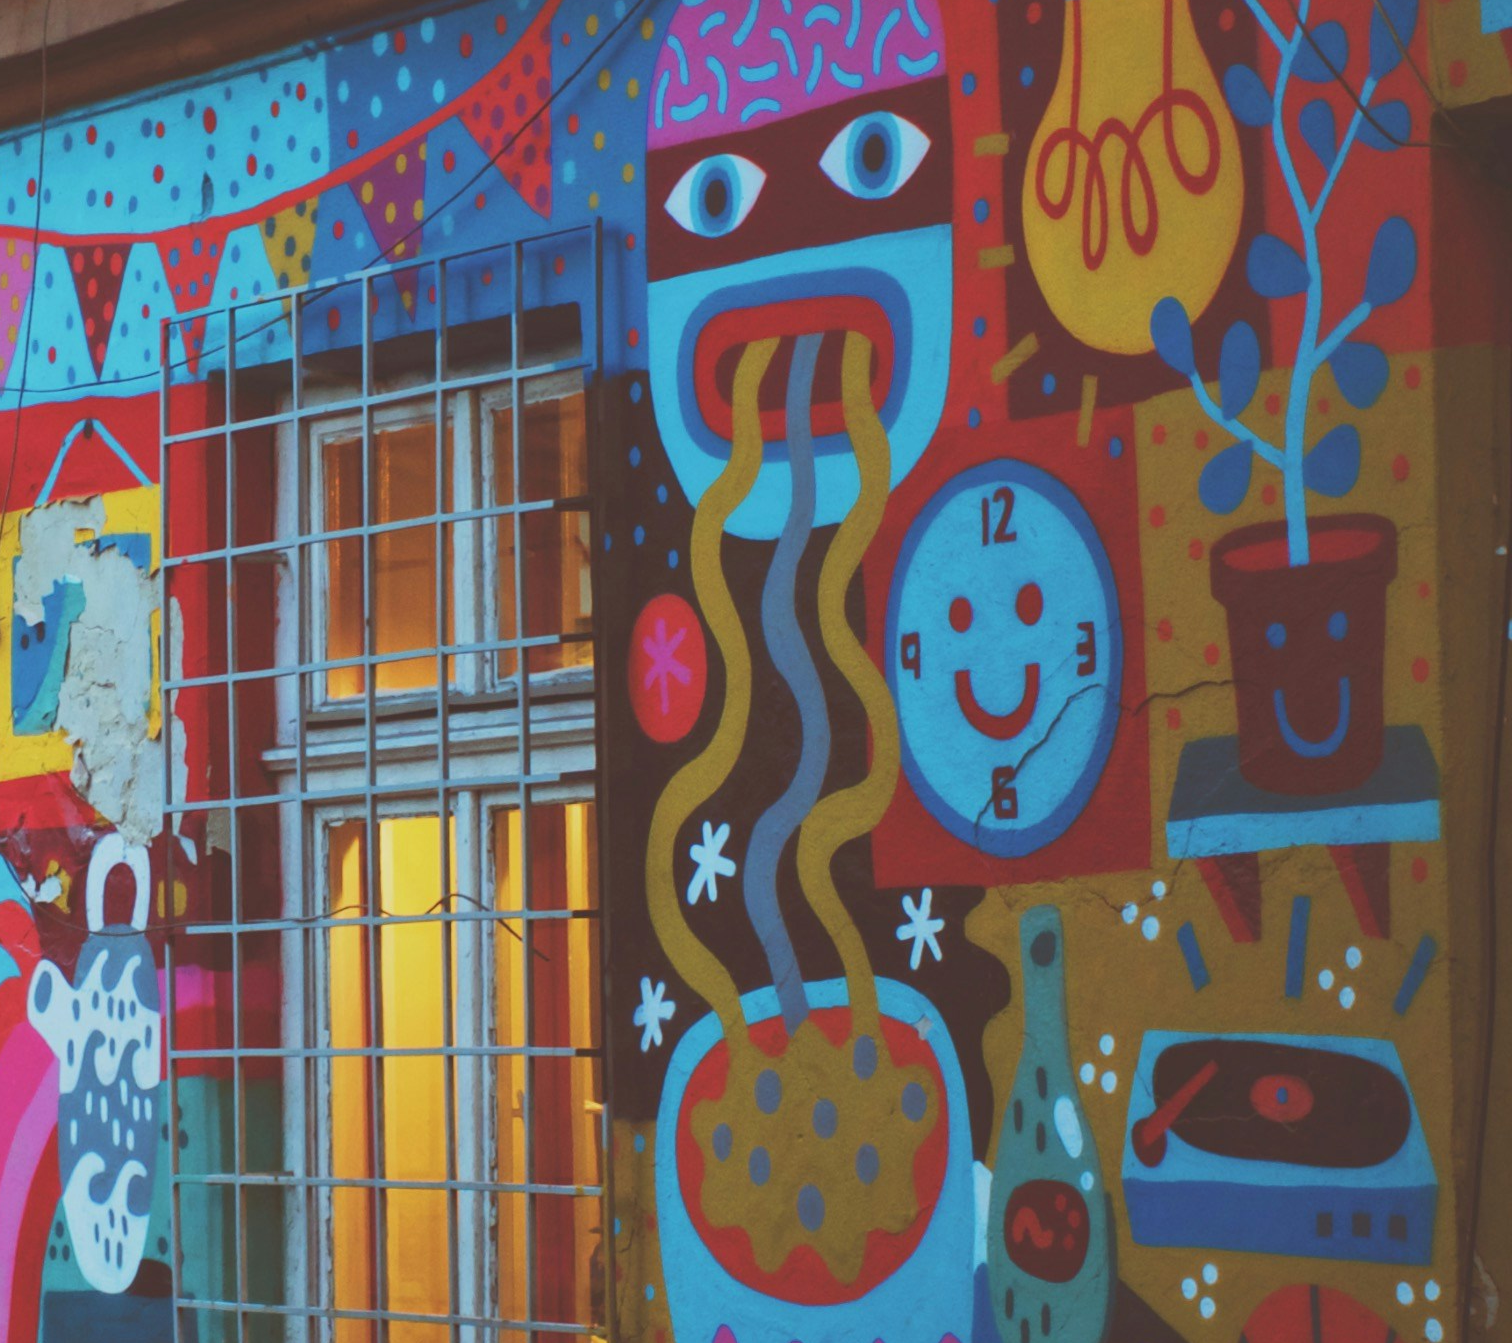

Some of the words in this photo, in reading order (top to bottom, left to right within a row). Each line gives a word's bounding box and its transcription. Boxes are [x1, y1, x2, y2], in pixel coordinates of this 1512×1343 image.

[982, 486, 1017, 546] 12
[901, 632, 921, 680] 9
[1076, 621, 1096, 677] 3
[992, 765, 1018, 820] 6
